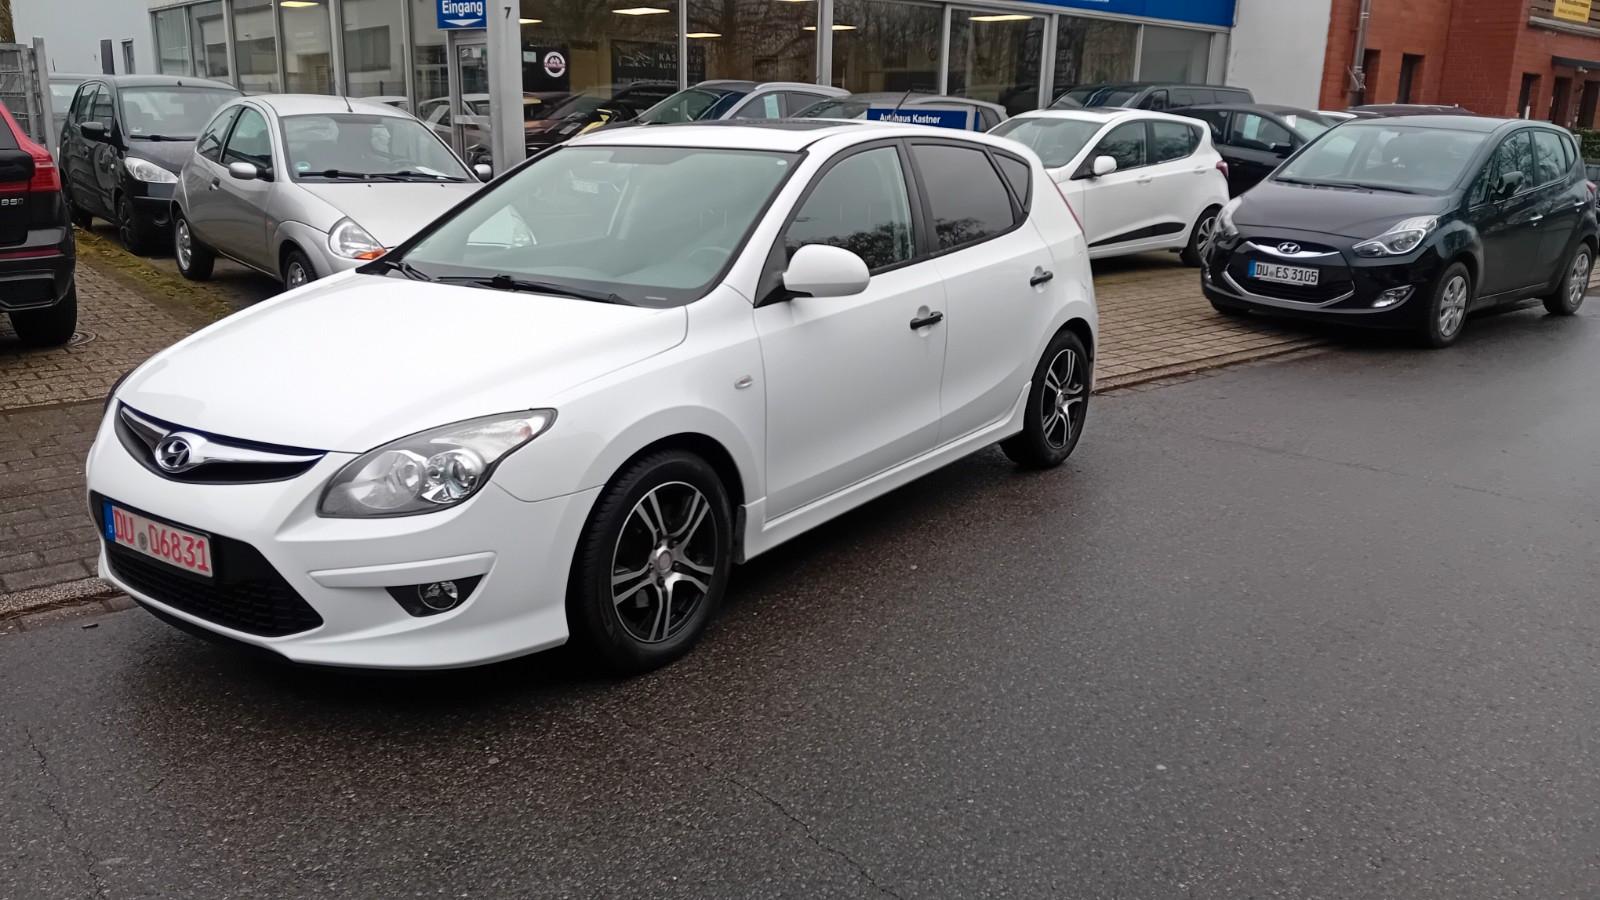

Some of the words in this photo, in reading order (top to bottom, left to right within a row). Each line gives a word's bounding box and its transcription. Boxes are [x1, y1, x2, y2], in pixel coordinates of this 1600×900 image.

[442, 0, 483, 17] Eingang
[504, 6, 512, 19] 7
[659, 52, 702, 64] KASER
[912, 114, 941, 124] Kastner
[1256, 264, 1269, 276] DU
[1275, 267, 1289, 279] ES
[1291, 268, 1317, 283] 3105
[113, 509, 135, 545] DU
[148, 524, 209, 572] 06831
